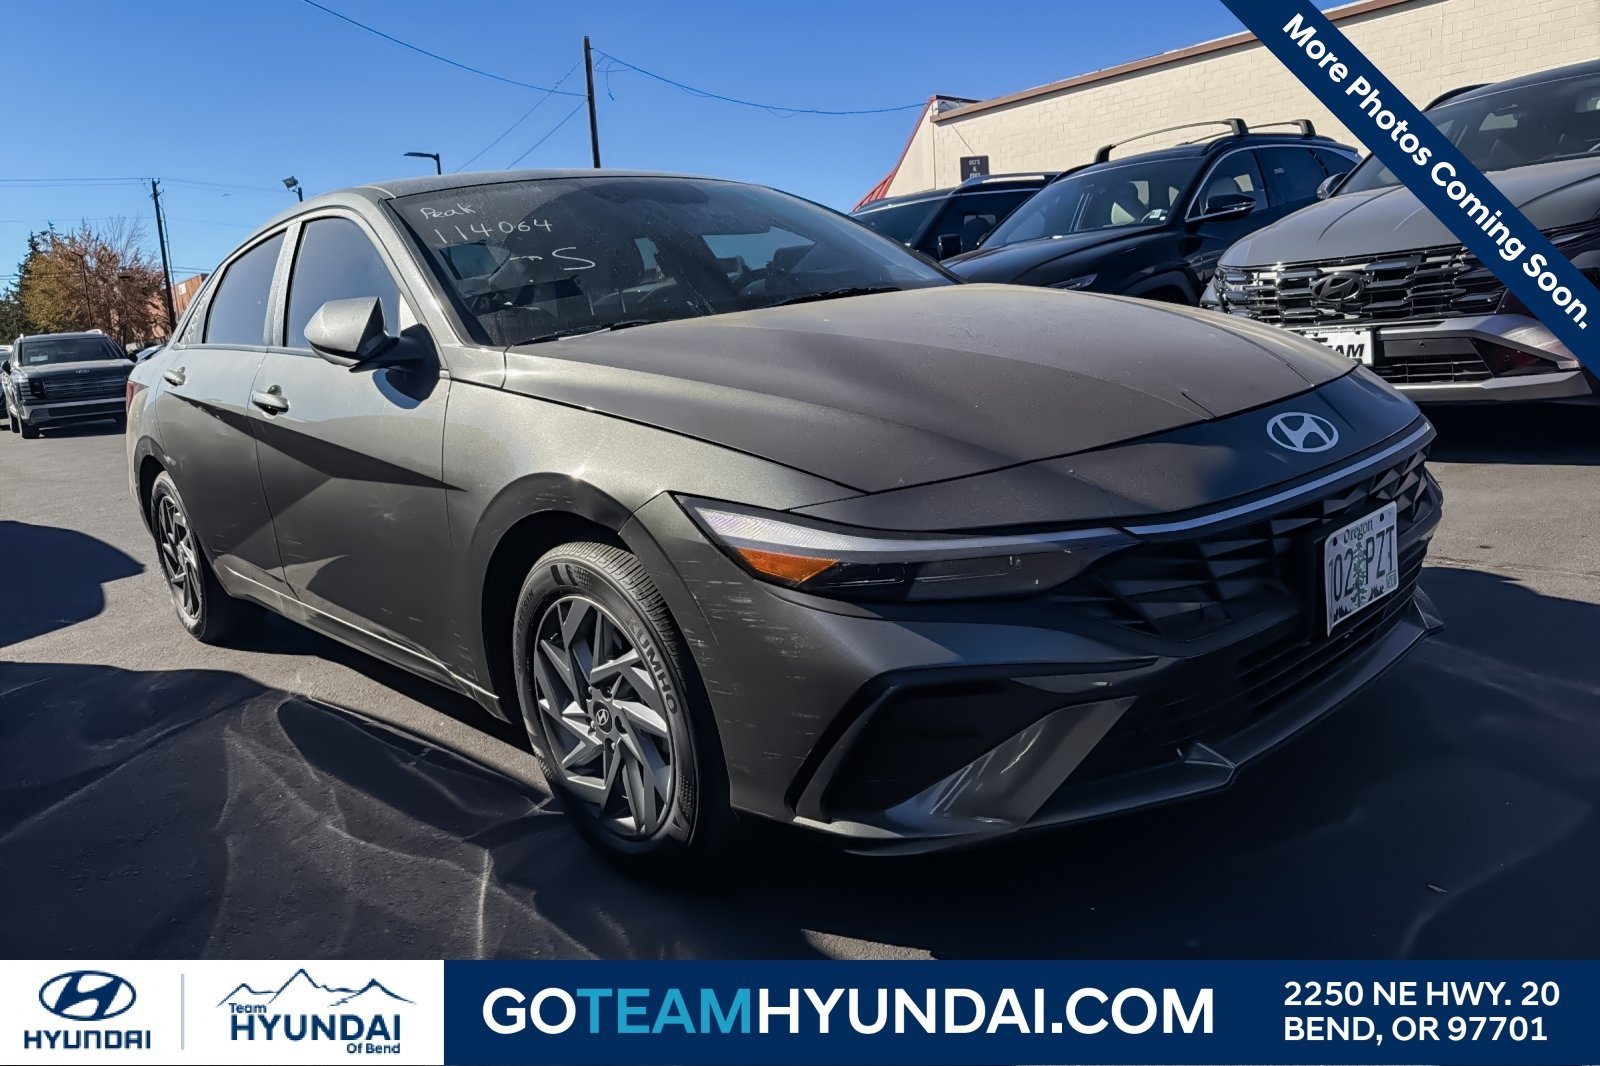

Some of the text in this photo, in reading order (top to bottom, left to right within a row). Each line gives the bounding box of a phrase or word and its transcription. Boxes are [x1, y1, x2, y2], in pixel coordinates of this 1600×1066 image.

[420, 203, 476, 219] Peak
[434, 218, 553, 244] 114064
[1343, 519, 1373, 543] Oregon
[1365, 525, 1395, 585] PZT
[629, 617, 677, 714] KUMHO
